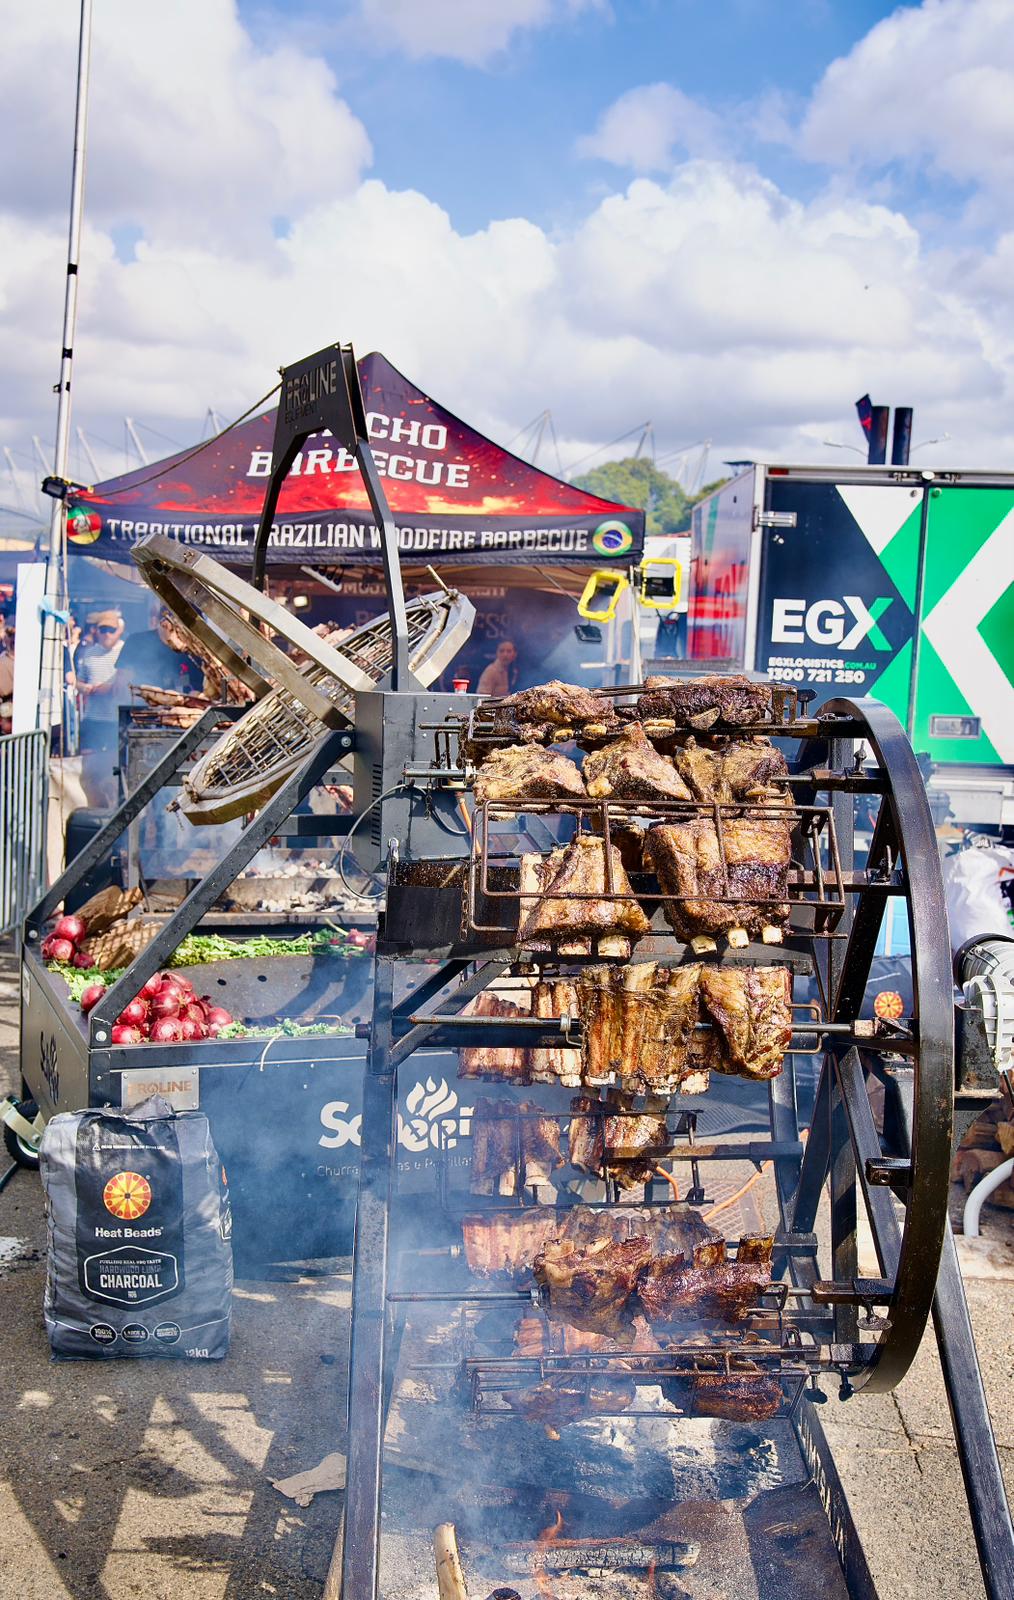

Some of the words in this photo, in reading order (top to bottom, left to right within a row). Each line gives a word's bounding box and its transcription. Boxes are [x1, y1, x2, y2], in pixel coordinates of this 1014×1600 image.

[286, 360, 337, 412] PROLINE
[107, 518, 249, 547] TRADITIONAL
[253, 523, 365, 548] RAZILIAN
[369, 525, 476, 550] WODFIRE
[480, 529, 588, 551] BARBECUE
[771, 596, 894, 651] EGX
[767, 668, 805, 681] 1300
[807, 669, 832, 682] 721
[834, 670, 866, 684] 250
[127, 1080, 193, 1097] PROLINE
[95, 1227, 122, 1238] Heat
[124, 1227, 162, 1238] Beads
[100, 1274, 163, 1289] CHARCOAL
